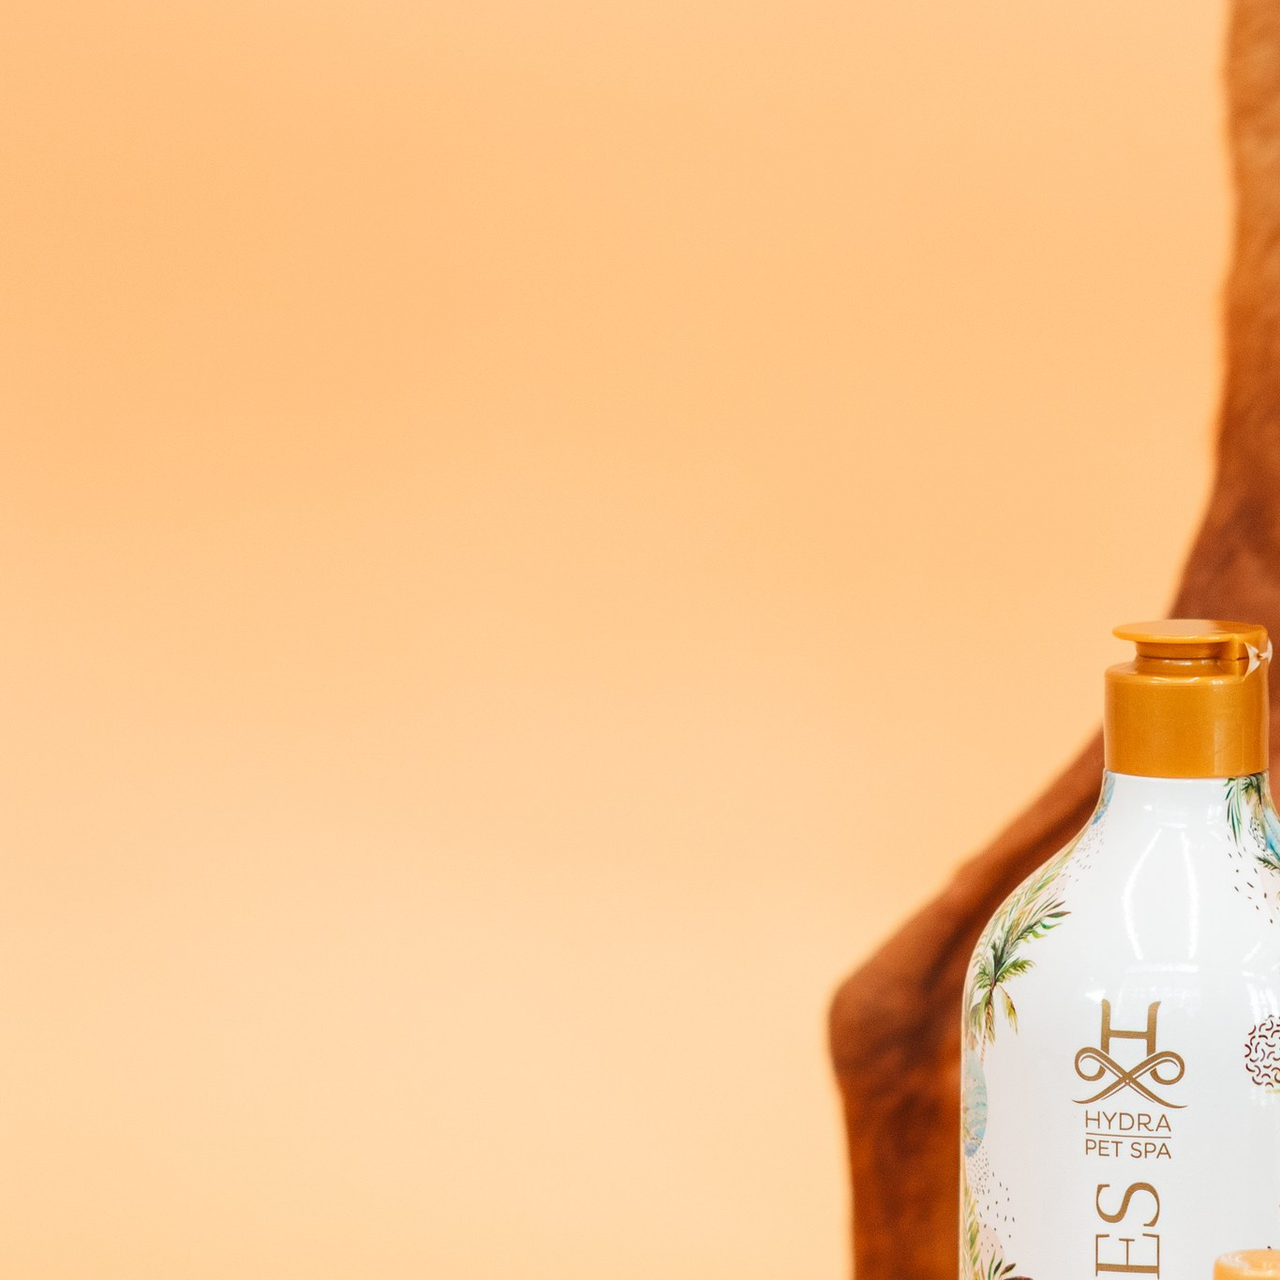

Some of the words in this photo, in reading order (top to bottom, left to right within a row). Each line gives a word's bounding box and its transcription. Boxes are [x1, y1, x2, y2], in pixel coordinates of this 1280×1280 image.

[1085, 1109, 1172, 1132] HYDRA
[1085, 1138, 1124, 1158] PET
[1130, 1141, 1172, 1160] SPA
